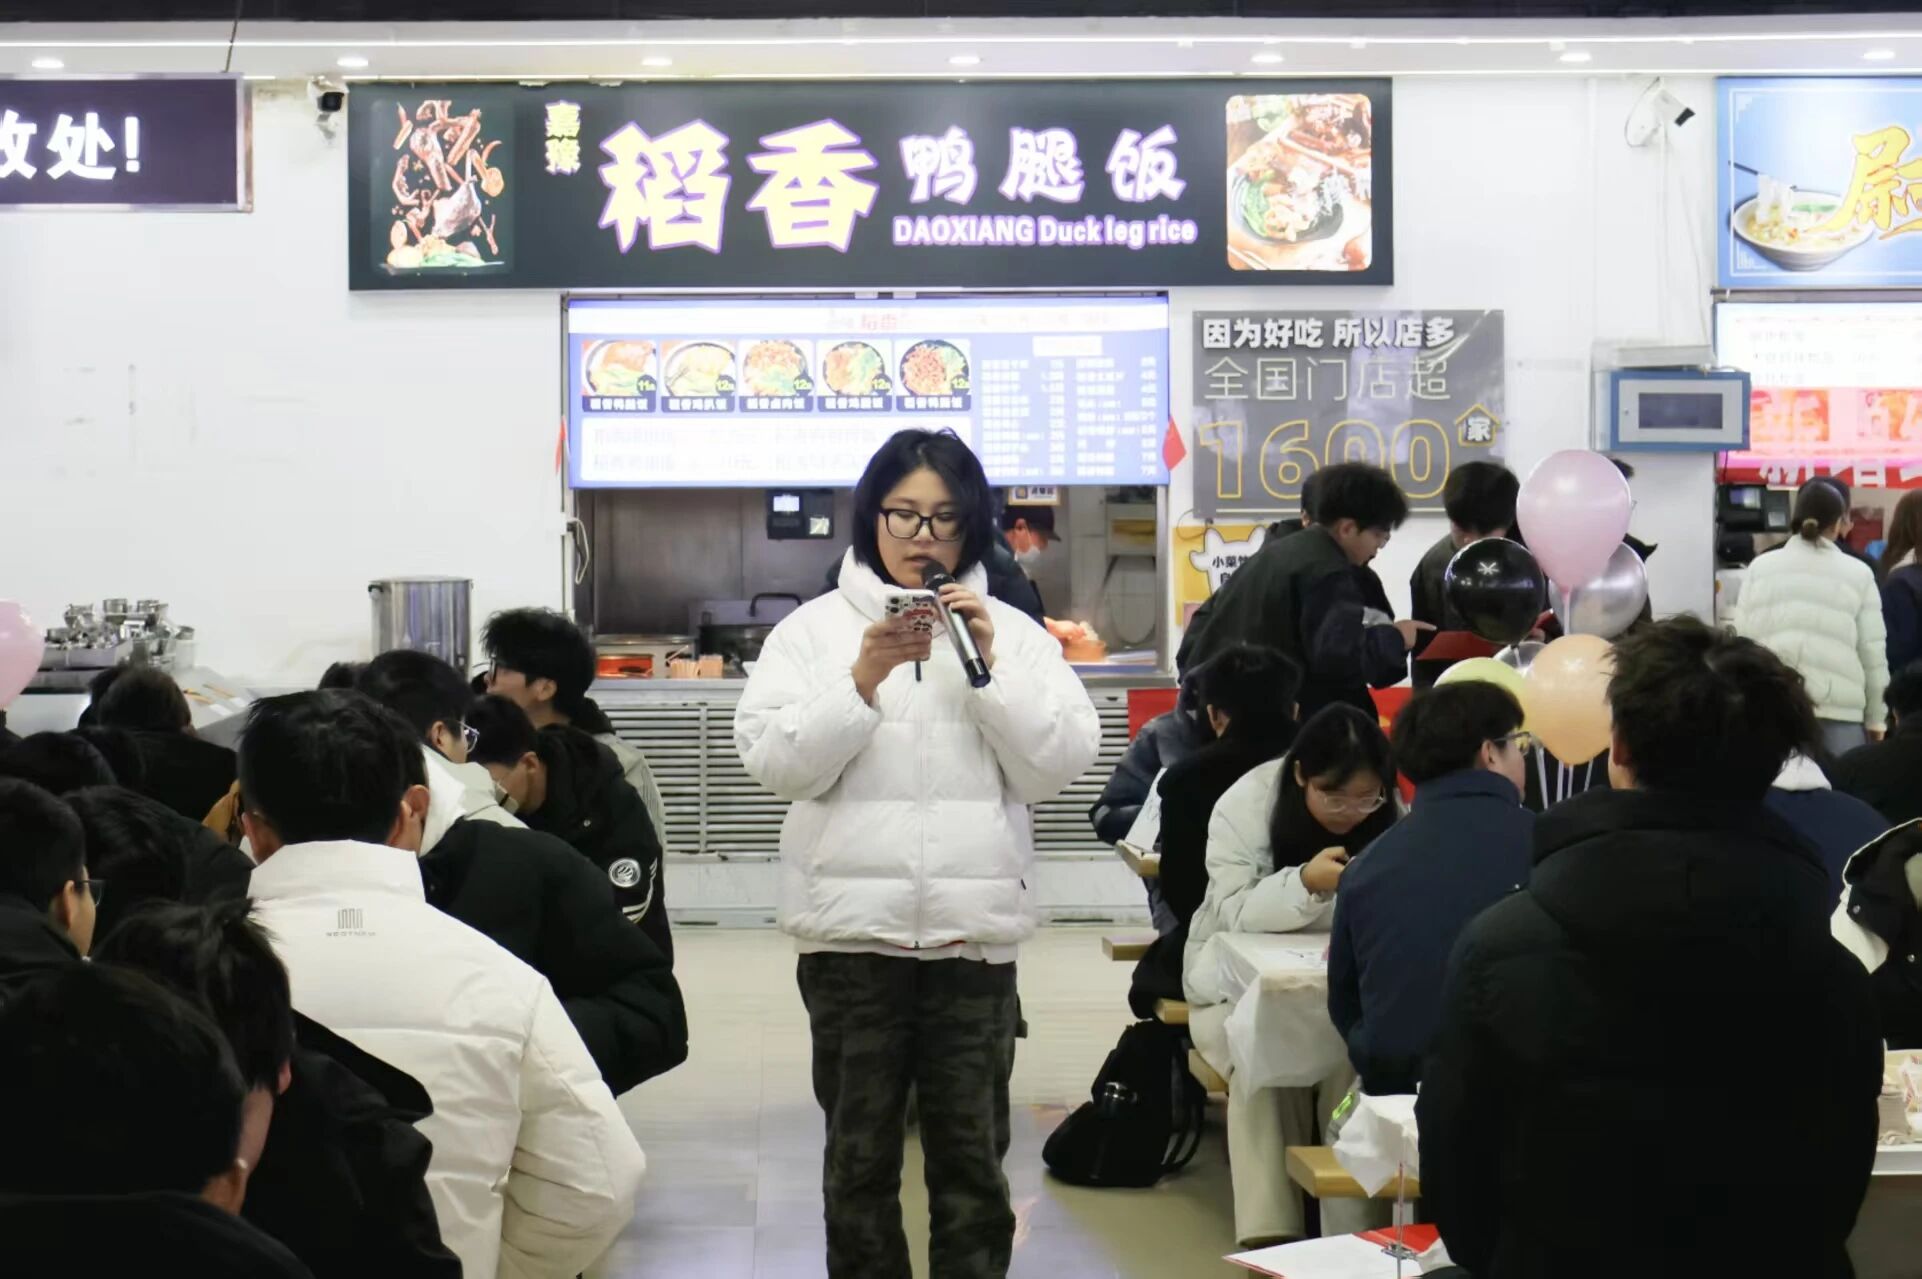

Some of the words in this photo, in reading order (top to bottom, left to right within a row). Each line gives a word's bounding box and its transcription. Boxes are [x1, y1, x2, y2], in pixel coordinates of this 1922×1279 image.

[598, 118, 880, 253] 稻香
[898, 124, 1187, 205] 鸭腿饭
[892, 214, 1036, 246] DAOXIANG
[1037, 215, 1103, 246] Duck
[1103, 214, 1147, 250] leg
[1147, 214, 1198, 245] rice
[1203, 318, 1324, 349] 因为好吃
[1332, 317, 1455, 349] 所以店多
[1203, 355, 1451, 401] 全国门店超
[1200, 418, 1451, 500] 1600
